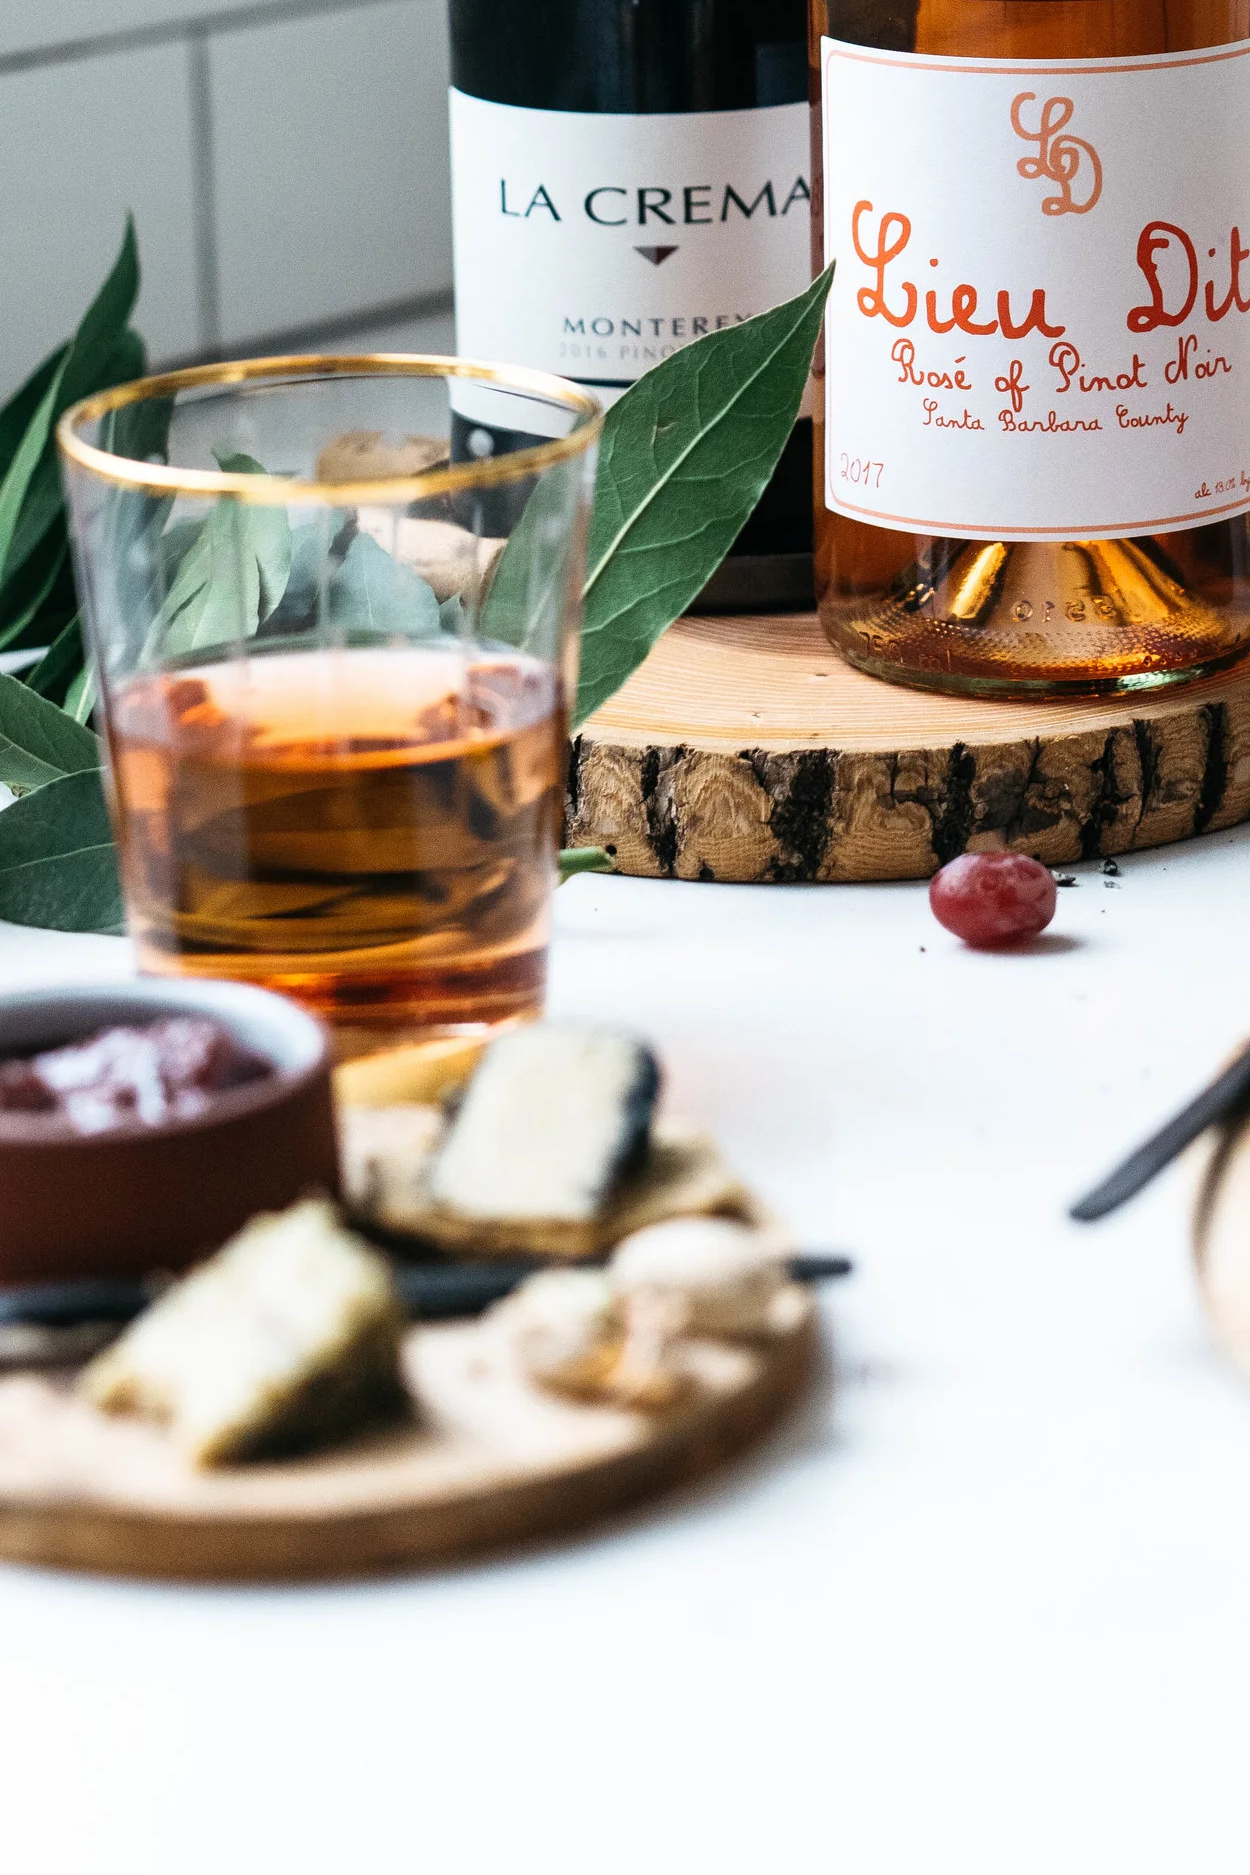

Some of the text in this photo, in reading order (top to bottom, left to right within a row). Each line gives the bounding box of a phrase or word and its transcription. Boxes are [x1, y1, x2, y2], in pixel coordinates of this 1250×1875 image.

[500, 175, 811, 226] LA CREMA
[851, 200, 1066, 339] Lieu
[558, 342, 607, 360] 2016
[890, 333, 1232, 413] Rosé of Pinot Noir
[922, 397, 1189, 436] Santa Barbara County
[840, 452, 884, 488] 2017
